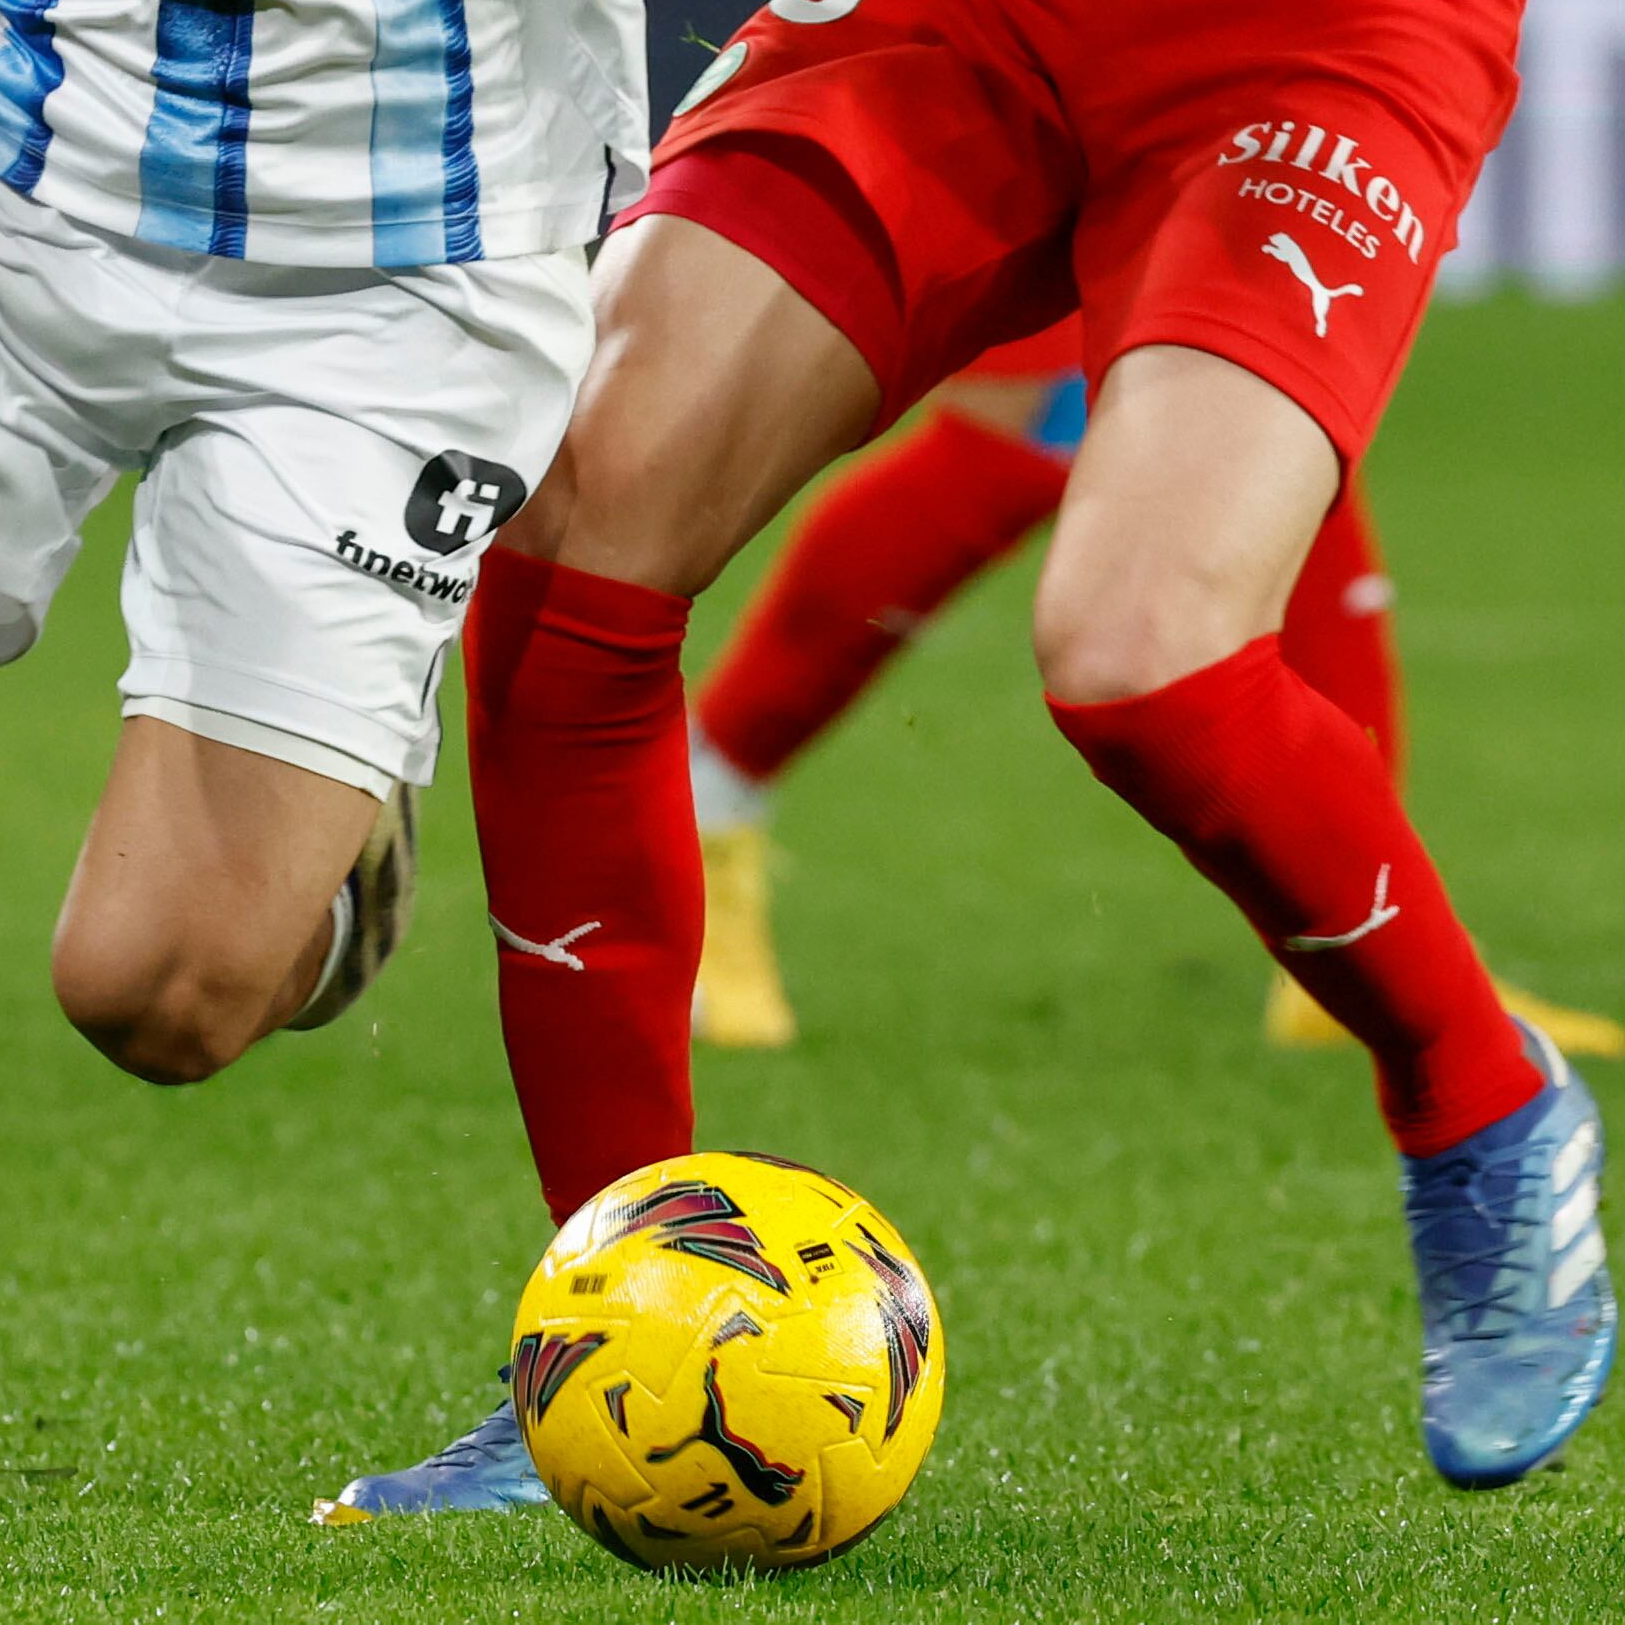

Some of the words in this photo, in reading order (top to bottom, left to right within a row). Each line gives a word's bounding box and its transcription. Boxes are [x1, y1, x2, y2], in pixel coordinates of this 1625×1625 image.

[1217, 120, 1424, 265] Silken
[1238, 177, 1381, 259] HOTELES
[335, 530, 474, 604] finetwo
